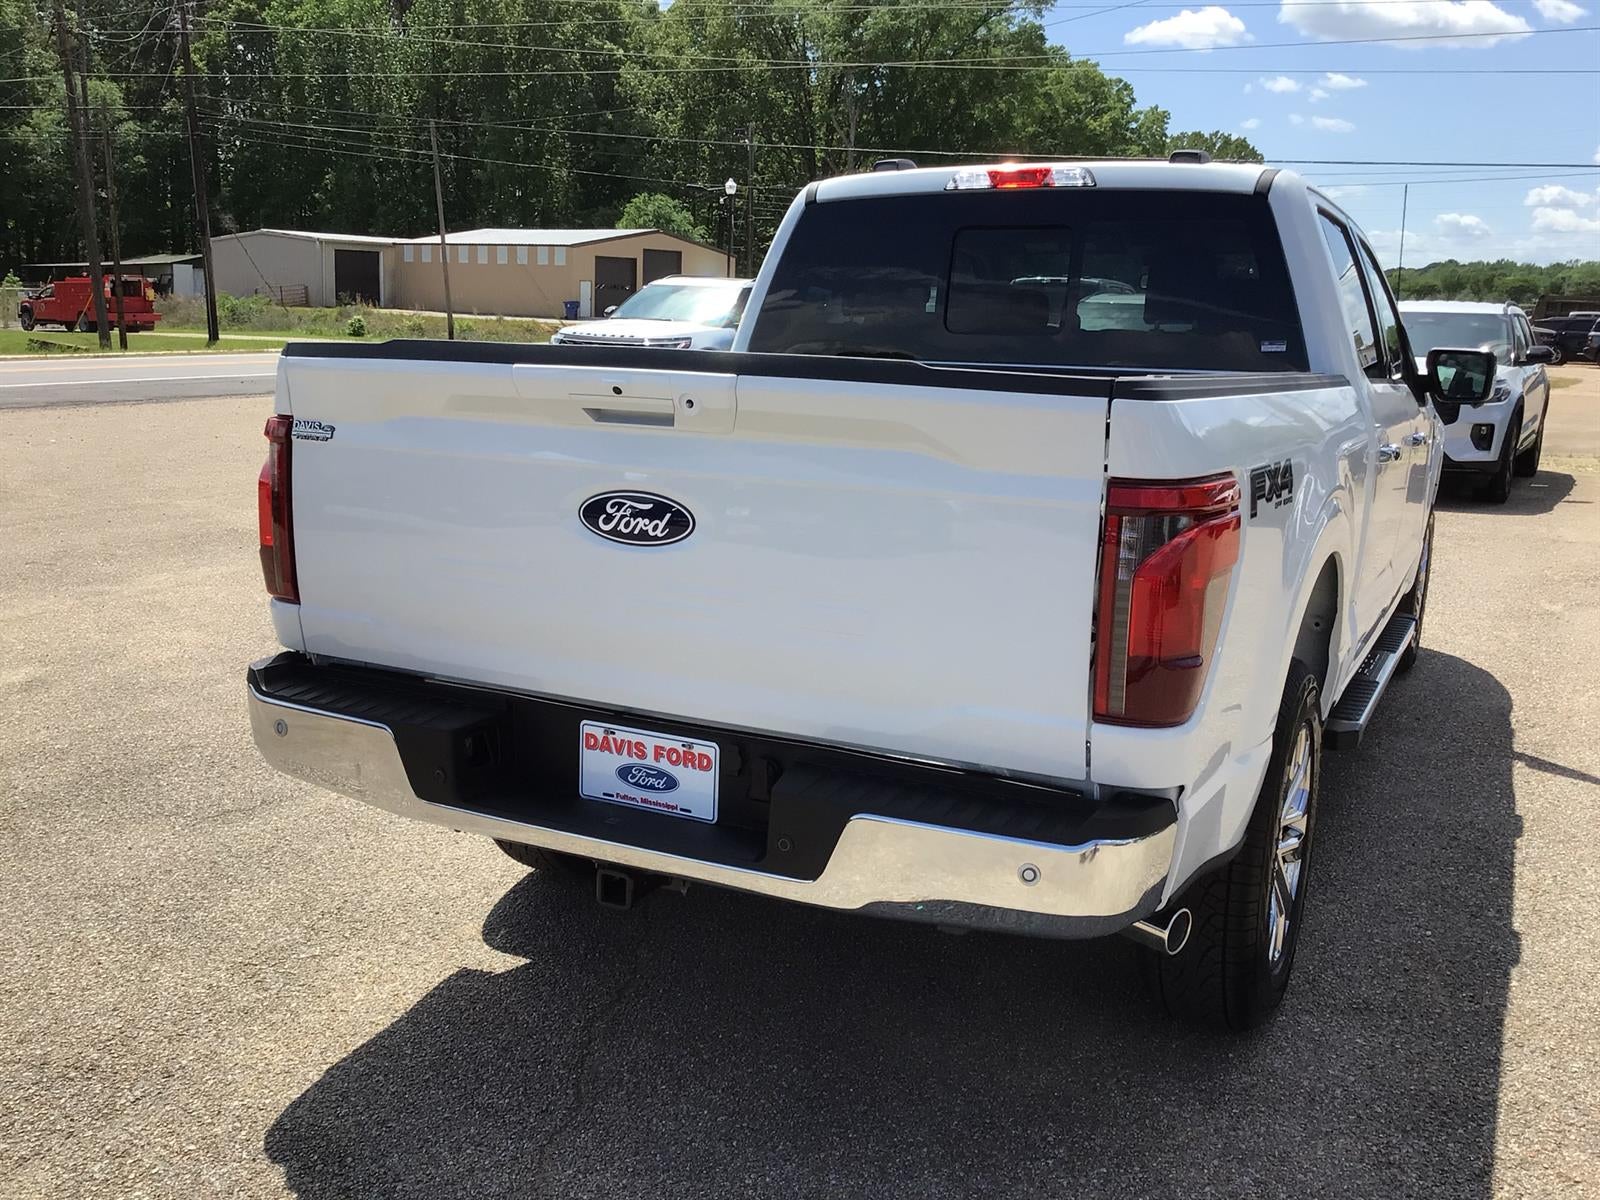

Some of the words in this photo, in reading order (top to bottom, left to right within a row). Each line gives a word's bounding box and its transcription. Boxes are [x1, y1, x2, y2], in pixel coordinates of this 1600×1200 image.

[295, 419, 322, 430] DAVIS
[1250, 458, 1293, 519] FX4
[598, 498, 672, 538] Ford
[584, 732, 647, 761] DAVIS
[653, 744, 713, 772] FORD
[627, 766, 667, 789] Ford
[615, 792, 640, 804] Fulton,
[640, 797, 679, 811] Mississippi
